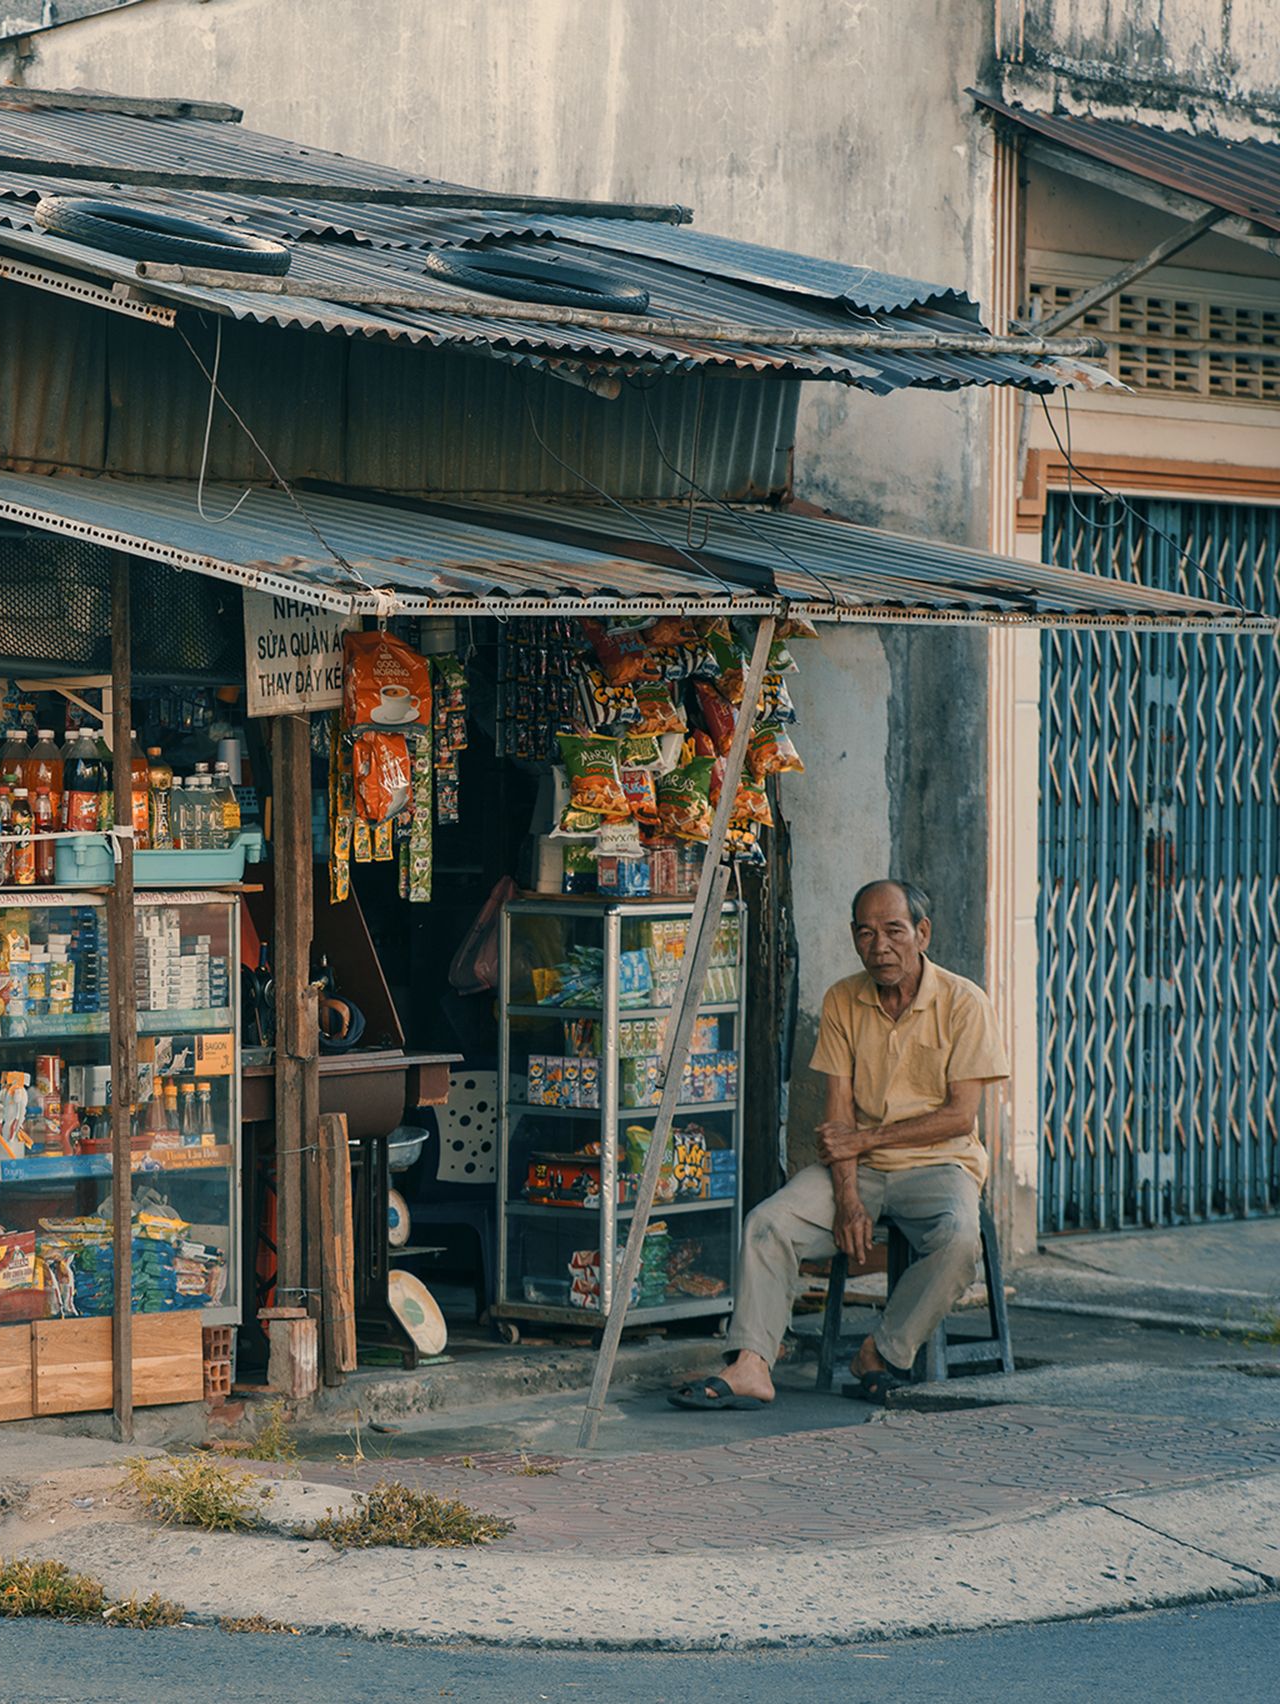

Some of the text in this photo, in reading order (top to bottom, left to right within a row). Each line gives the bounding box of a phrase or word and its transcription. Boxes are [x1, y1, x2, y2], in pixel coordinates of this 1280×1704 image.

[257, 629, 288, 660] SỬA
[290, 625, 329, 657] QUẦN
[259, 671, 292, 697] THAY
[325, 661, 345, 690] KÉ
